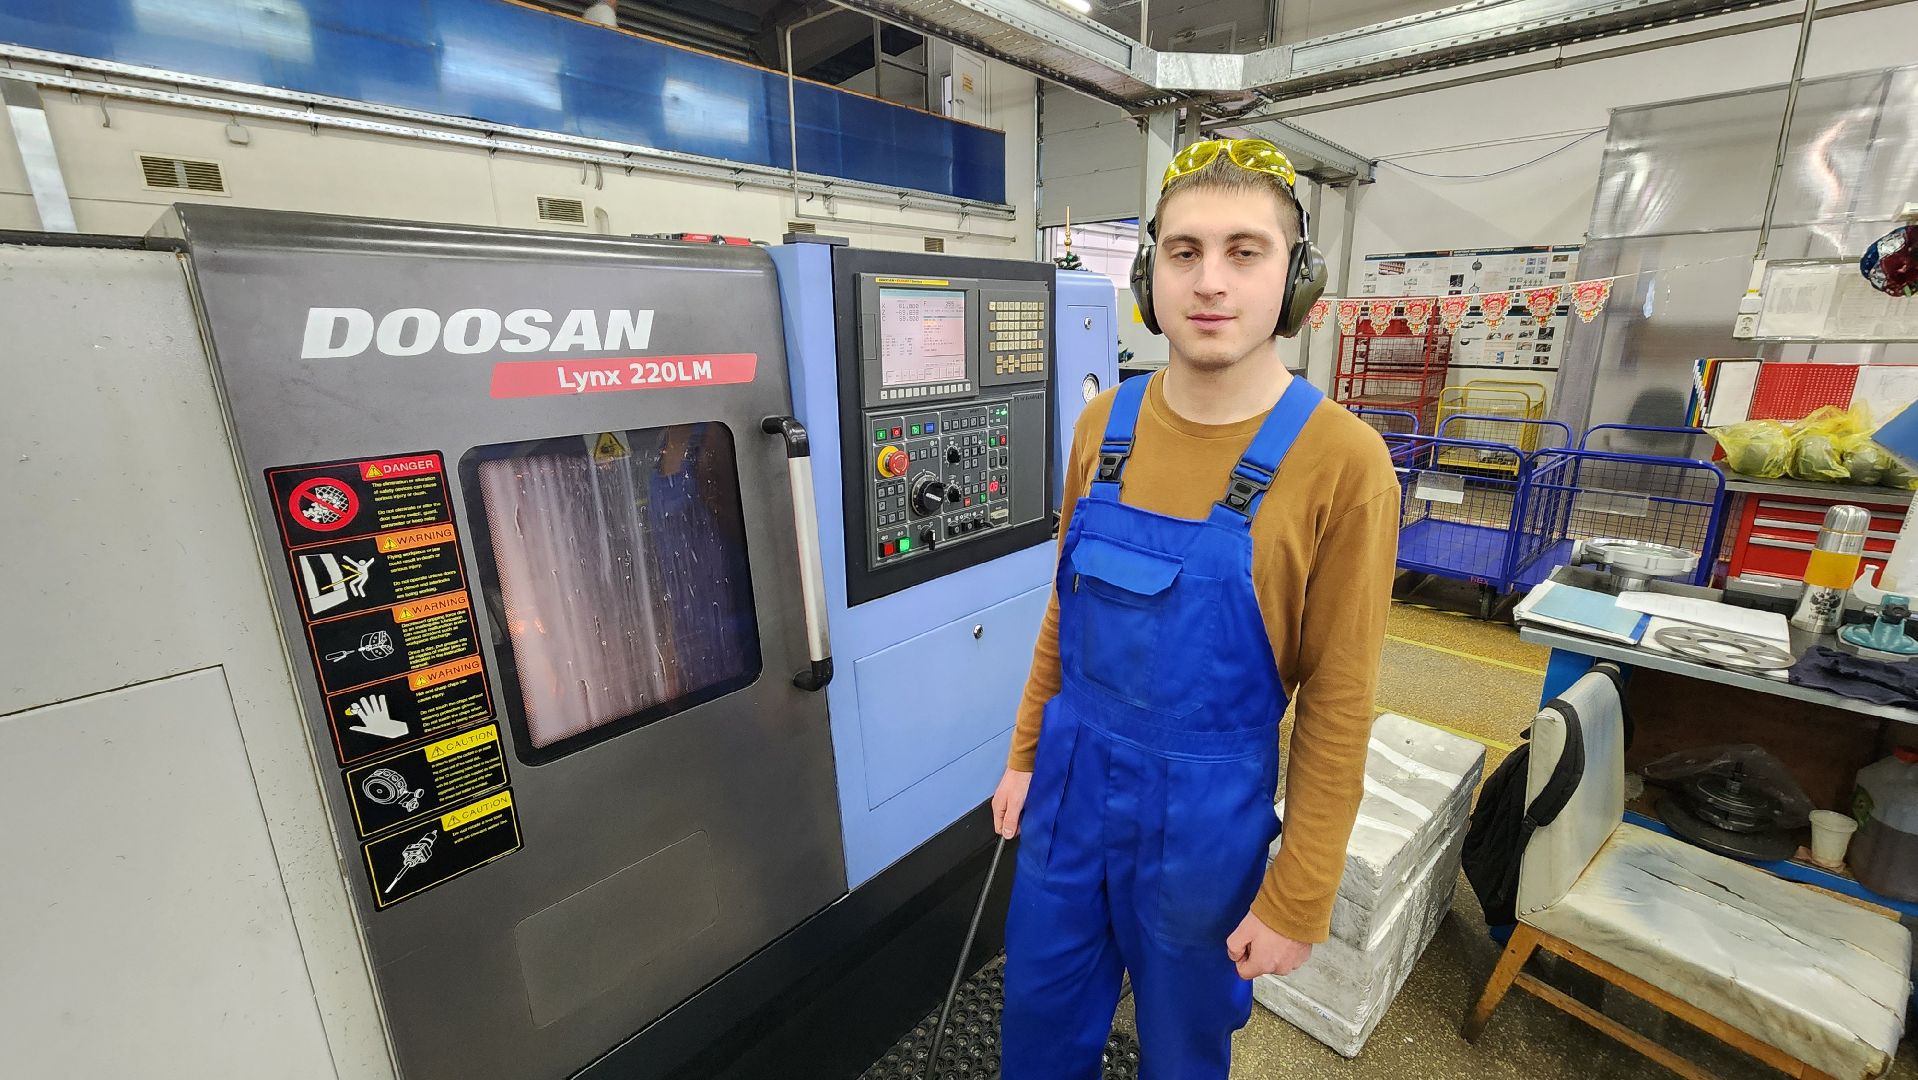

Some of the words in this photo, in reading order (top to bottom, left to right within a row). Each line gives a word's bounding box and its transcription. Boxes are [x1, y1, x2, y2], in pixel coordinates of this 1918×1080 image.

[301, 307, 655, 359] DOOSAN
[557, 366, 621, 394] Lynx
[630, 360, 713, 385] 220LM
[383, 460, 434, 473] DANGER
[396, 529, 452, 544] WARNING
[412, 597, 466, 613] WARNING
[428, 661, 479, 680] WARNING
[447, 730, 493, 750] CAUTION
[462, 796, 507, 819] CAUTION
